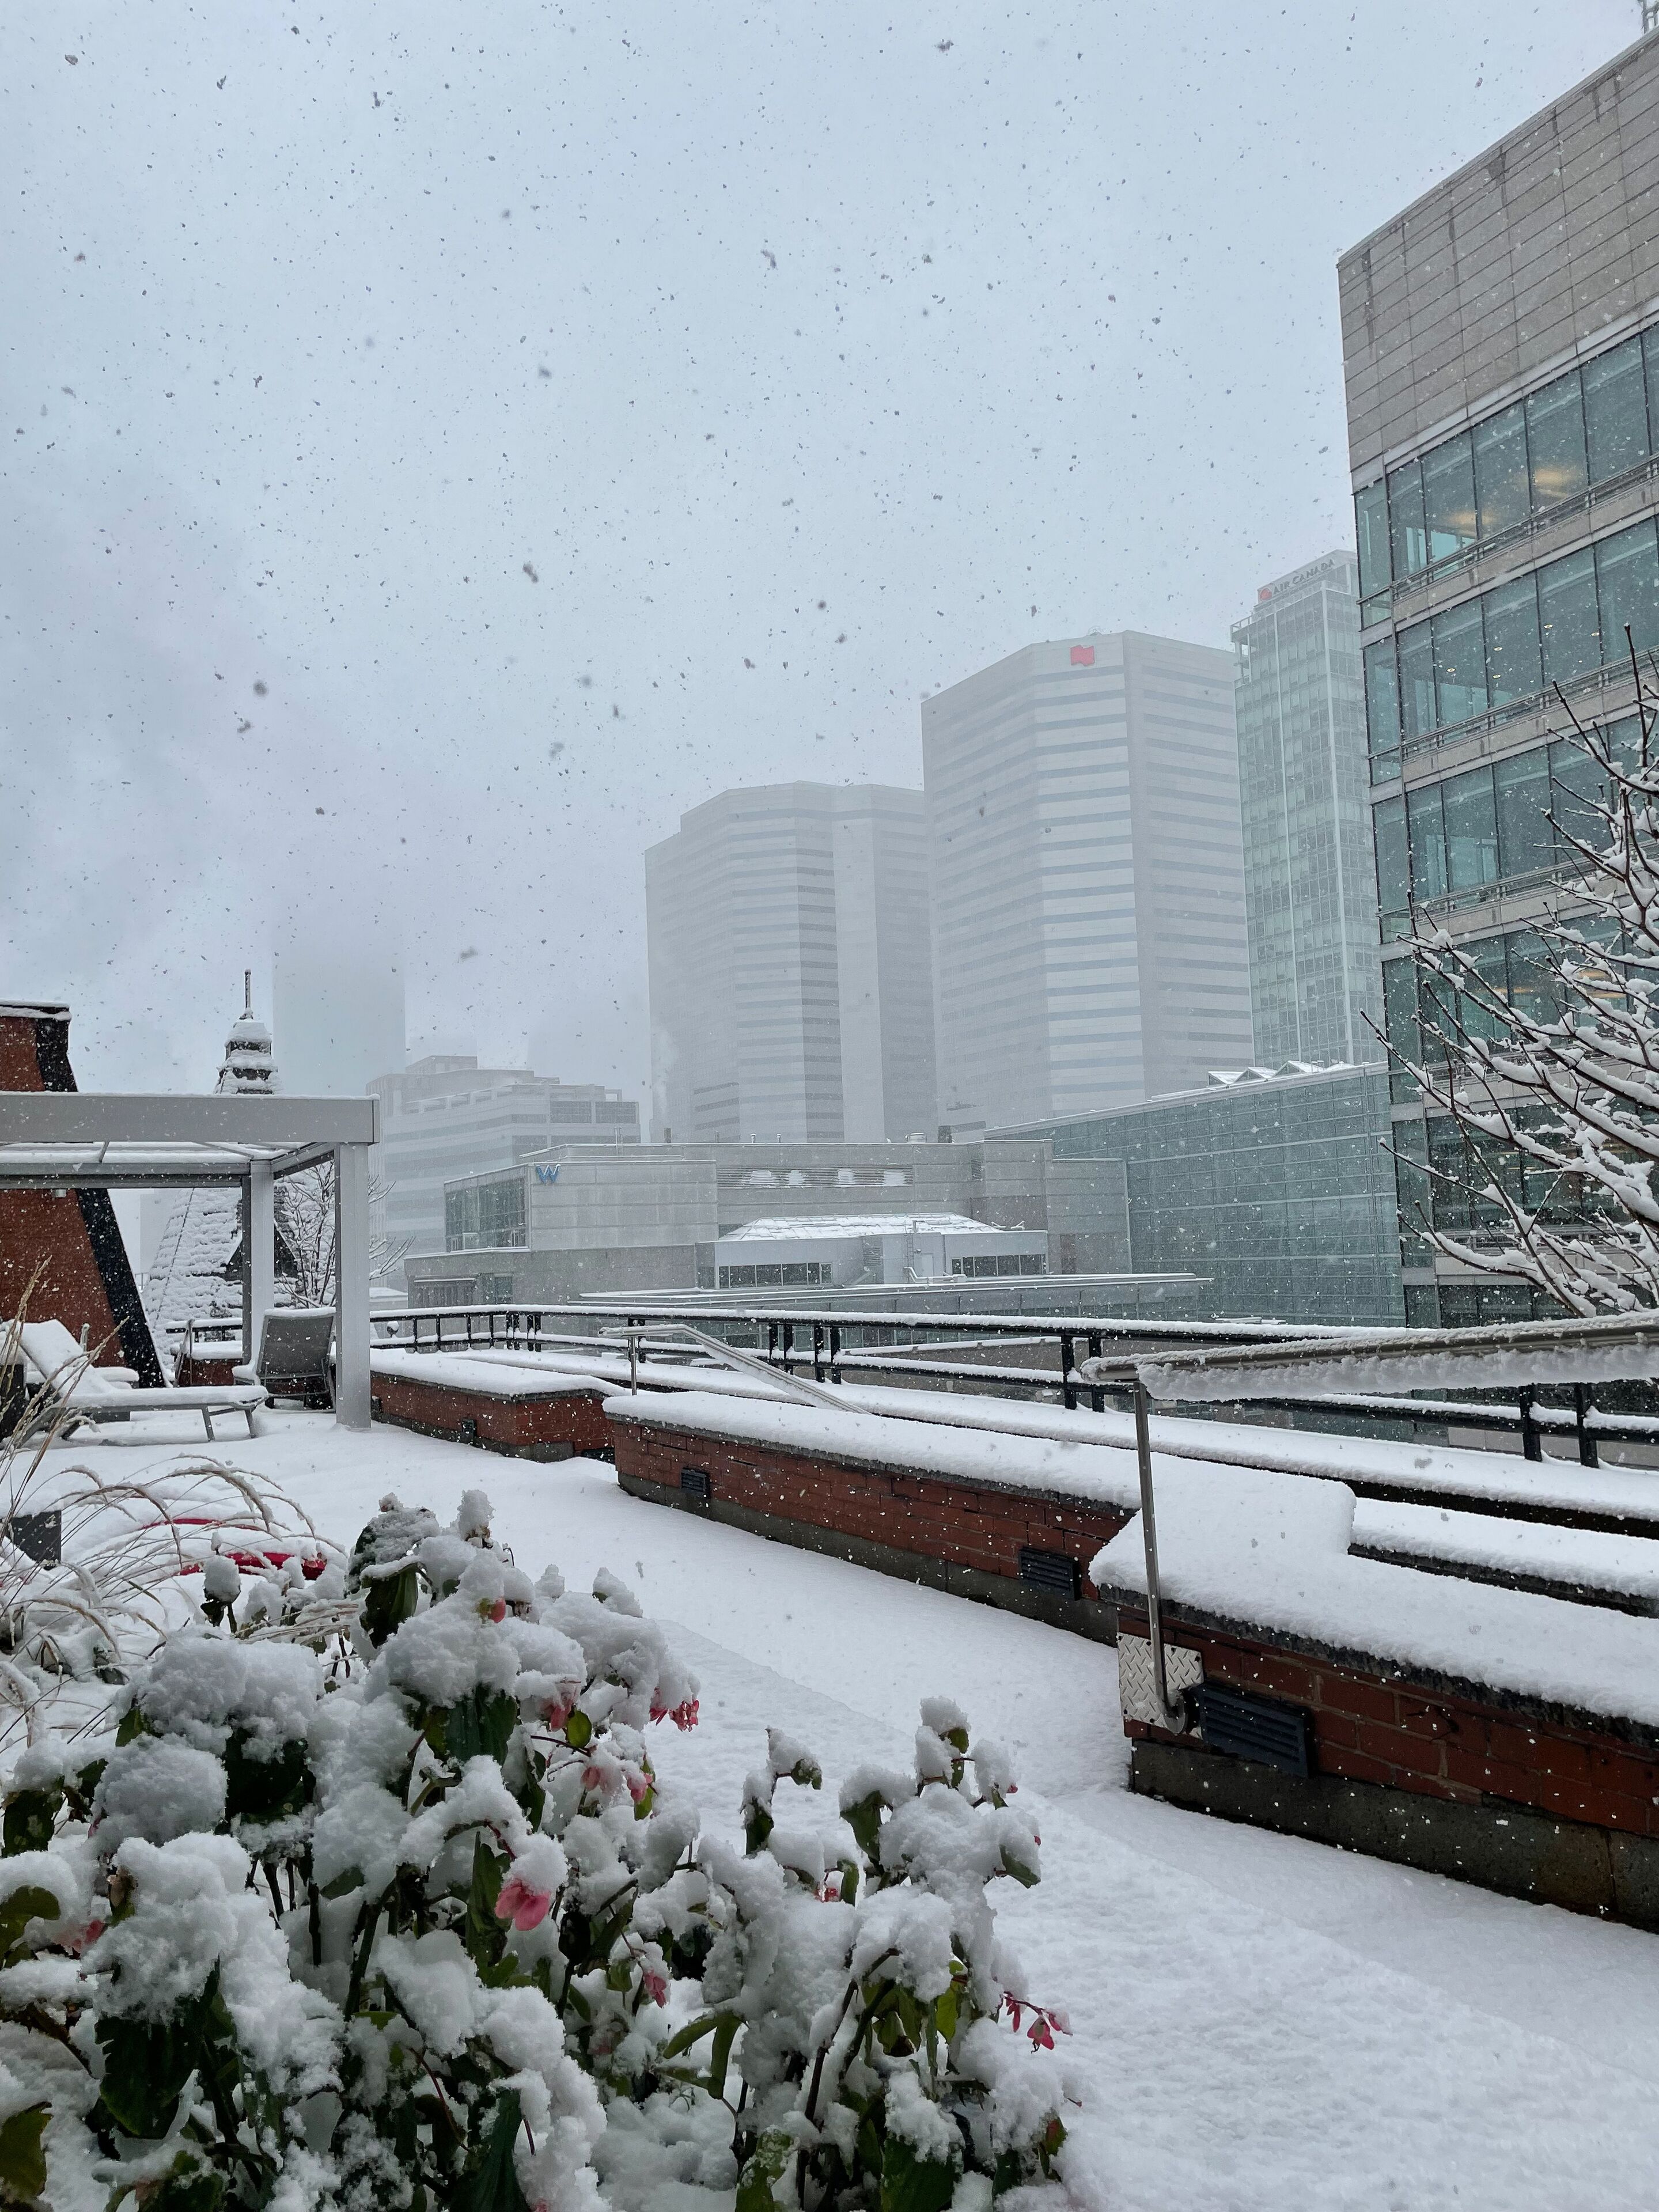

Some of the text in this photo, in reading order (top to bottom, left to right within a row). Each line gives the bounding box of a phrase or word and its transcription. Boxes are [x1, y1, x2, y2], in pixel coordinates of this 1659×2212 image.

[1274, 559, 1335, 594] AIR CANADA
[535, 1164, 561, 1184] W
